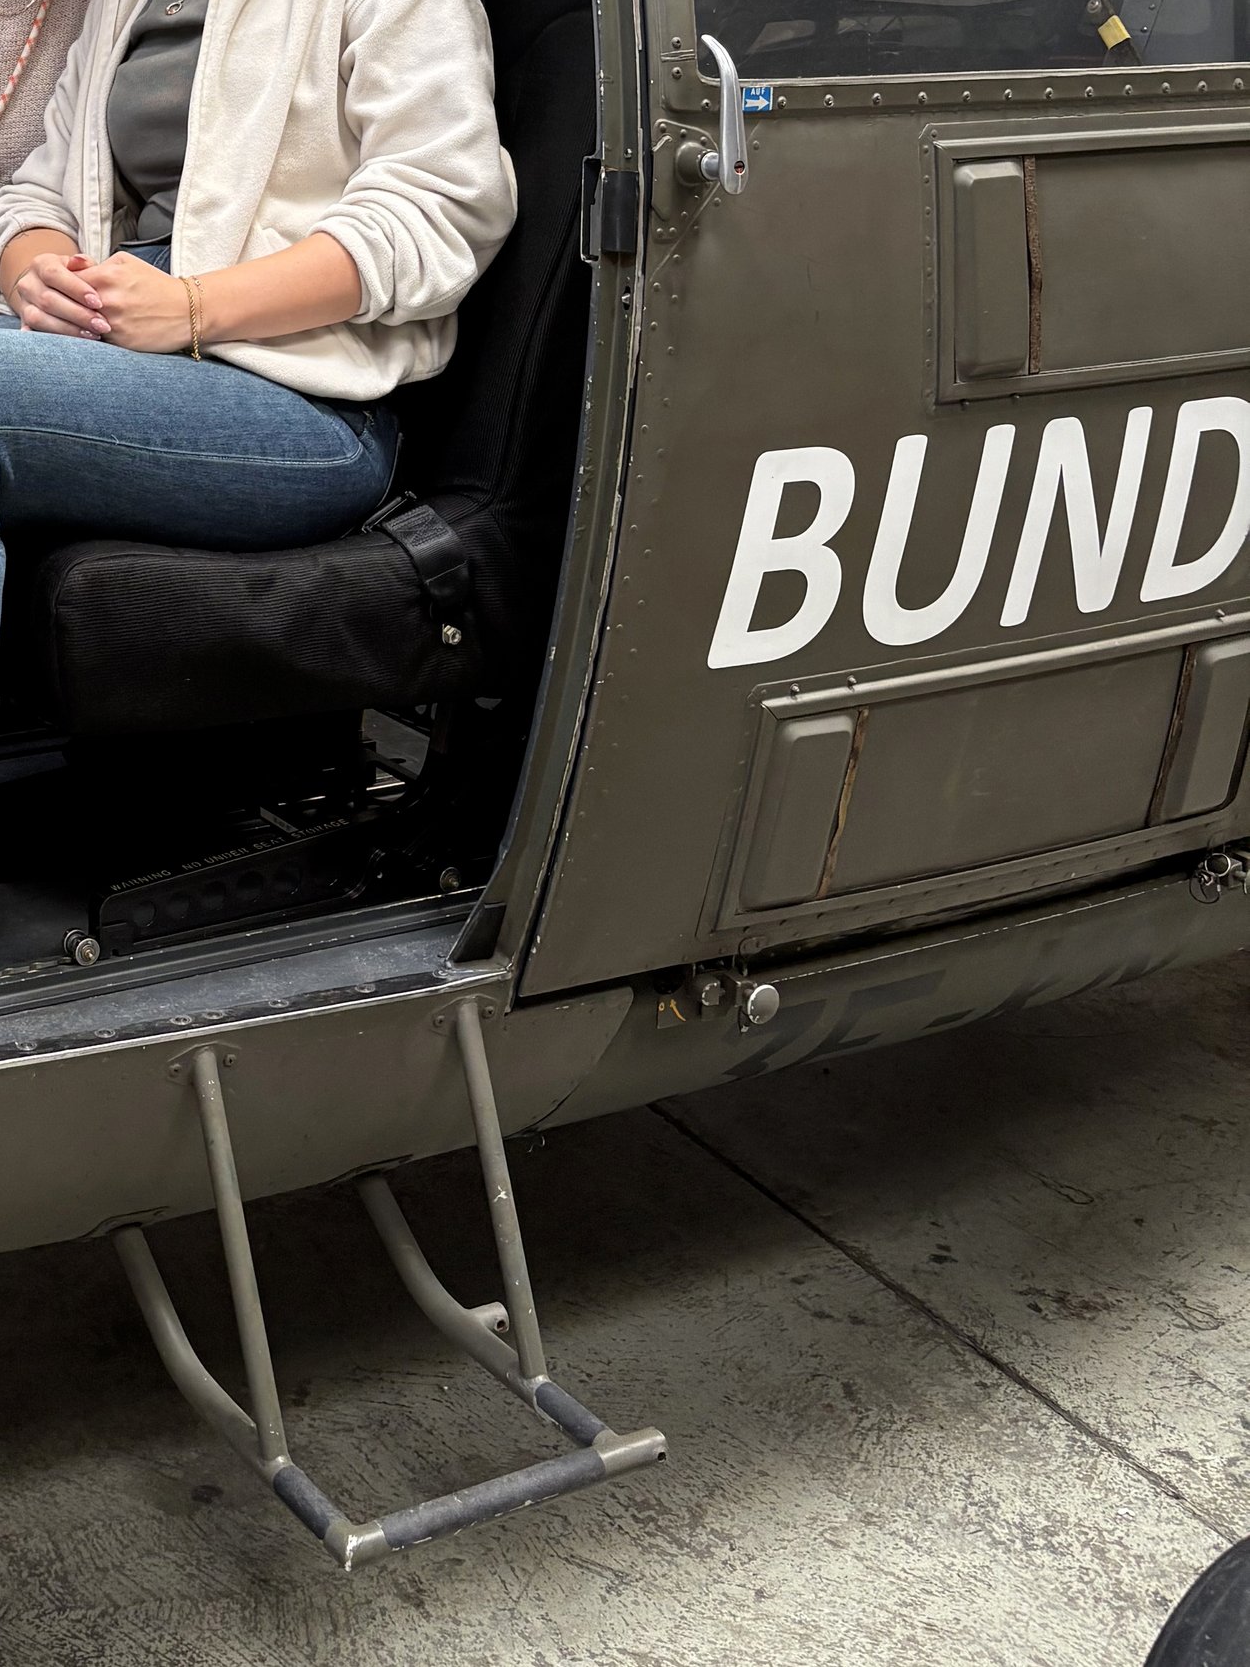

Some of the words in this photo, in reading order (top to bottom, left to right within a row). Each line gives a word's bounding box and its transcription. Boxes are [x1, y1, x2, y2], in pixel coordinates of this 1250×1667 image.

[751, 87, 766, 95] AUF
[707, 396, 1250, 669] BUND
[110, 869, 172, 892] WARNING
[182, 861, 202, 871] NO
[204, 847, 249, 865] UNDER
[252, 836, 286, 851] SEAT
[290, 818, 350, 840] STORAGE
